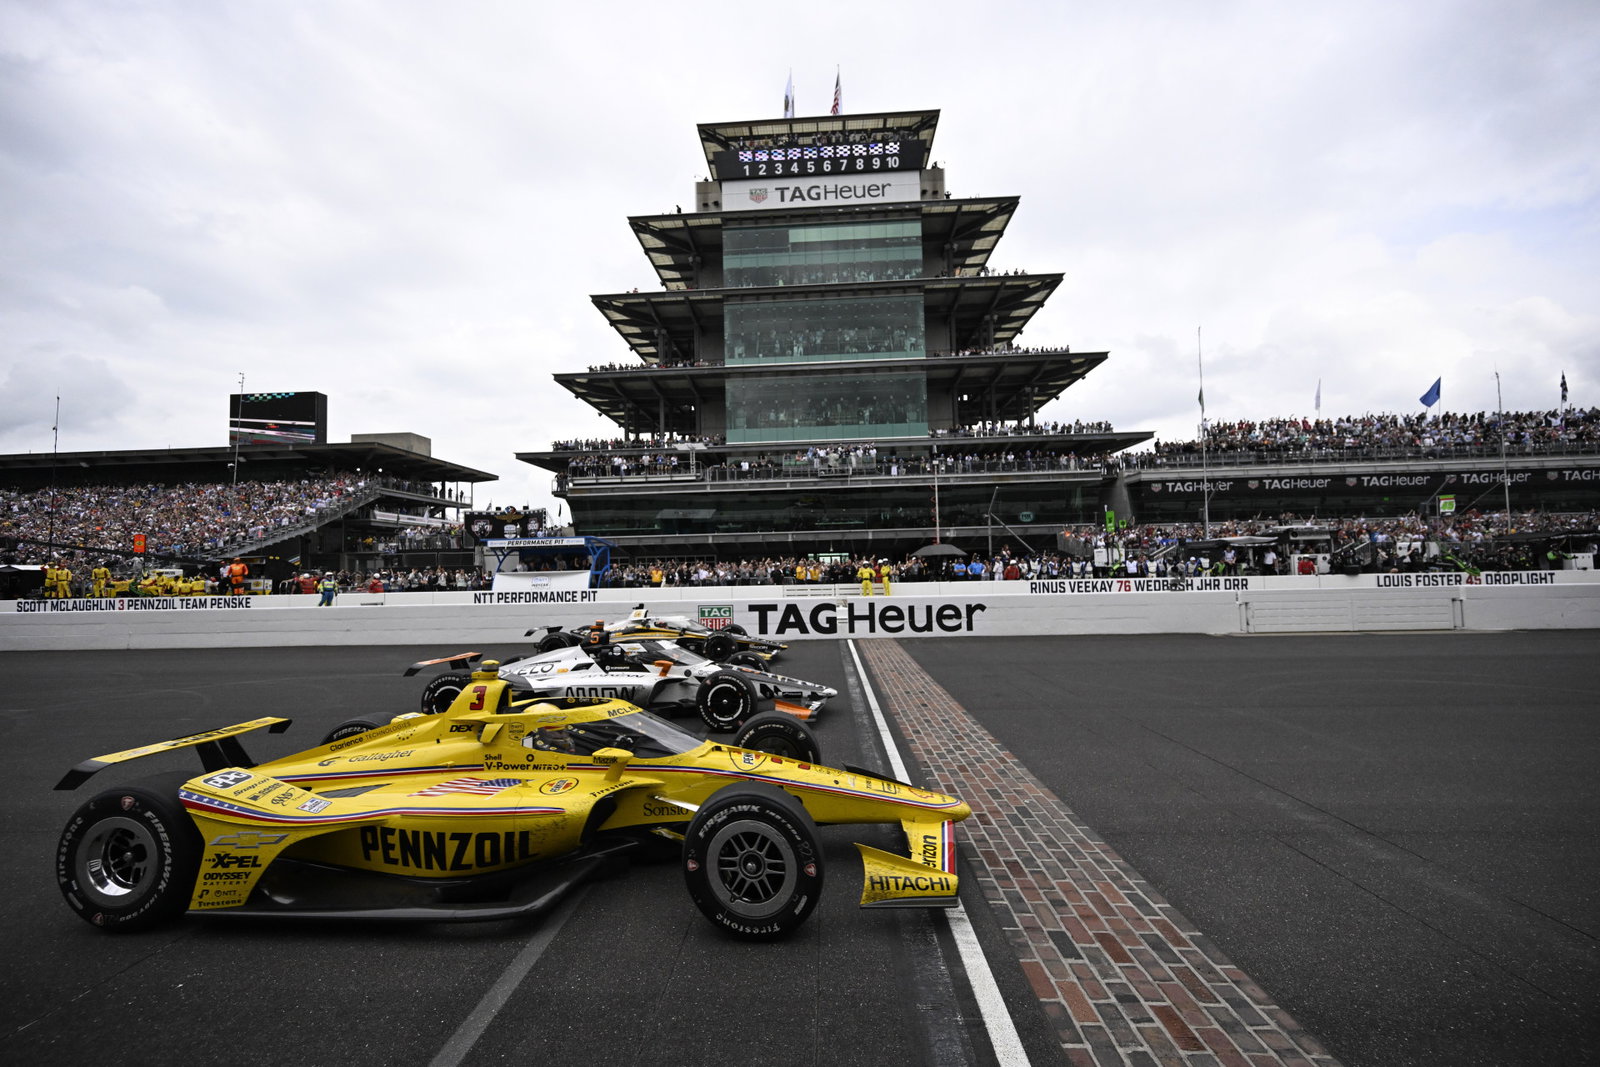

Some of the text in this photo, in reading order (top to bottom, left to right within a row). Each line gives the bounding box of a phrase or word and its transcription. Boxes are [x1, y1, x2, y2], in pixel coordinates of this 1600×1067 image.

[743, 156, 899, 176] 1 2 3 4 5 6 7 8 9 10
[774, 182, 892, 202] TAGHeuer
[1263, 478, 1331, 490] TAGHeuer
[1361, 476, 1430, 486] TAGHeuer
[1030, 581, 1066, 594] RINUS
[1068, 580, 1114, 593] VEEKAY
[1116, 580, 1131, 592] 76
[1196, 578, 1220, 591] JHR
[1224, 578, 1248, 590] DRR
[1377, 575, 1412, 587] LOUIS
[1416, 574, 1462, 586] FOSTER
[1486, 572, 1556, 584] DROPLIGHT
[16, 598, 251, 612] SCOTT MCLAUGHLIN 3 PENNZOIL TEAM PENSKE
[474, 591, 598, 604] NTT PERFORMANCE PIT
[702, 608, 730, 616] TAG
[748, 602, 987, 635] TAGHeuer
[590, 632, 600, 644] 5
[654, 660, 673, 677] 7
[430, 676, 460, 688] Firestone
[470, 686, 487, 710] 3
[450, 724, 473, 733] DEX
[330, 736, 364, 752] Clarience
[365, 721, 411, 740] TECHNOLOGIES
[349, 750, 416, 763] Gallagher
[593, 756, 618, 764] Mazak
[485, 762, 530, 770] V-Power
[208, 772, 247, 788] PPG
[590, 780, 634, 797] Firestone
[644, 803, 688, 816] Sonsio
[698, 805, 760, 839] FIREHAWK
[58, 816, 83, 884] Firestone
[144, 811, 172, 893] FIREHAWK
[360, 825, 539, 871] PENNZOIL
[211, 853, 262, 868] XPEL
[204, 872, 251, 880] ODYSSEY
[870, 876, 950, 891] HITACHI
[716, 914, 780, 934] Firestone
